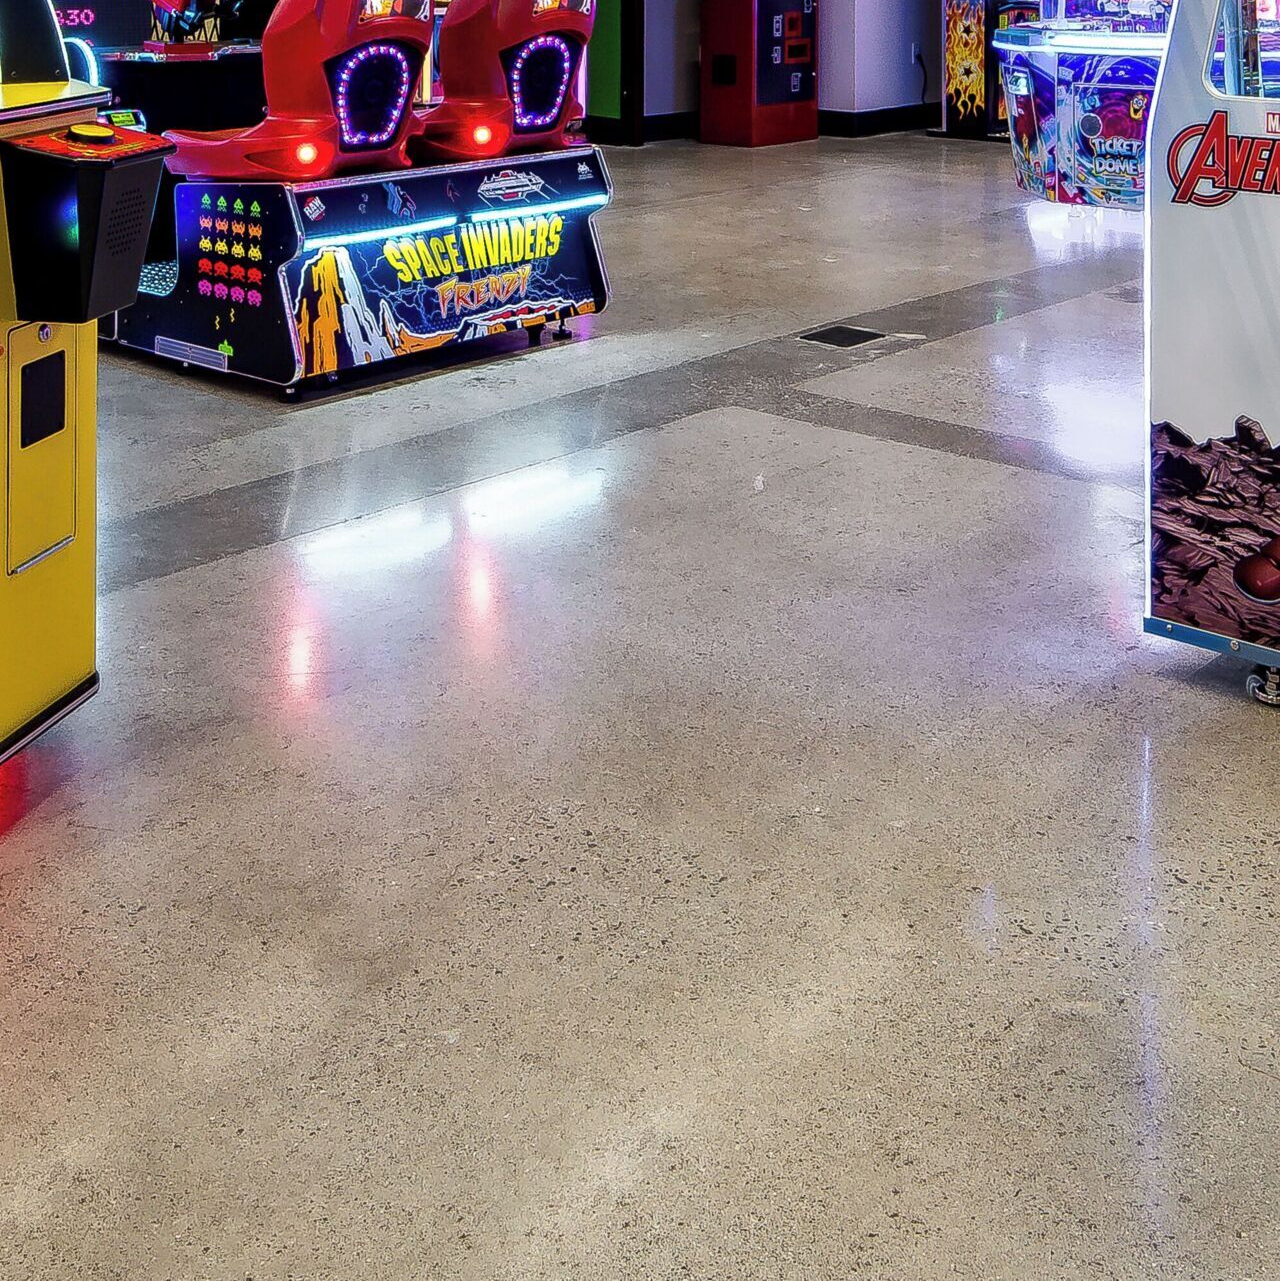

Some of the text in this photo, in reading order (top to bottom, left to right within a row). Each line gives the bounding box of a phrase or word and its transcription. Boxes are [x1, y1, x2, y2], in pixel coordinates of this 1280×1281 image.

[1094, 157, 1139, 175] DOME
[383, 214, 565, 283] SPACE INVADERS
[435, 264, 533, 318] FRENZY
